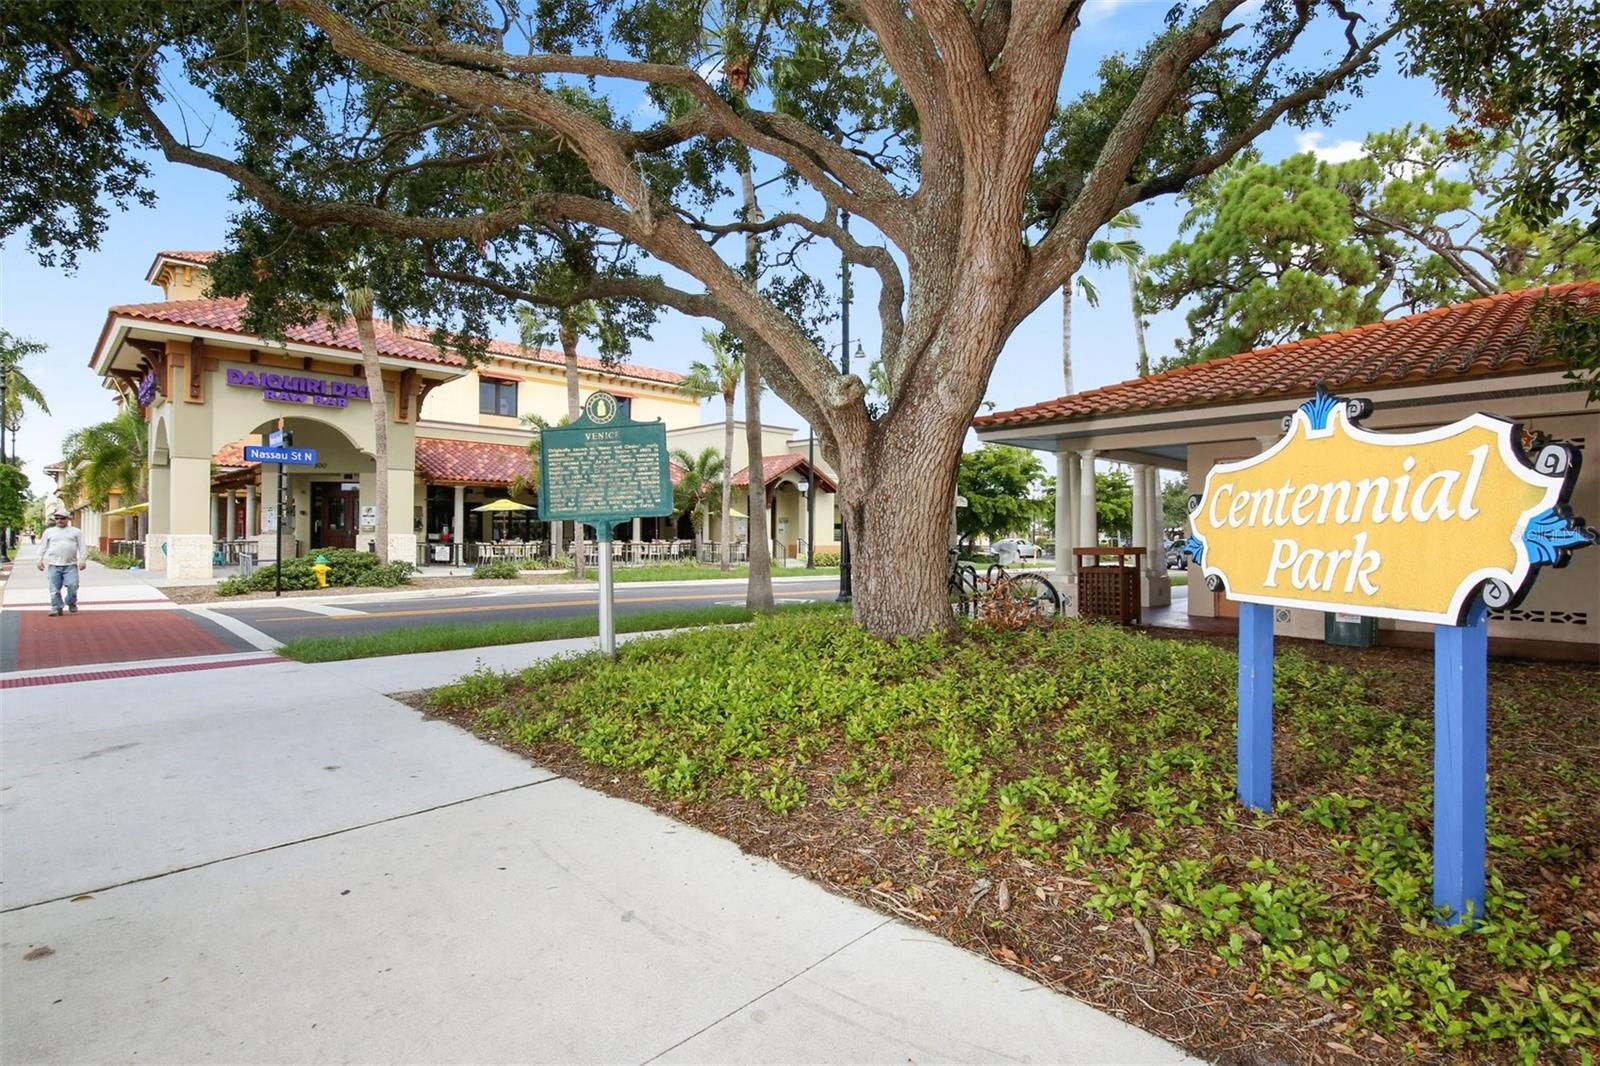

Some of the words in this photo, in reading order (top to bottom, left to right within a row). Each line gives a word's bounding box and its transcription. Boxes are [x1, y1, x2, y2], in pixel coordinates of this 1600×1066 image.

[226, 368, 327, 394] DAIQUIRI
[331, 381, 369, 399] DEC
[264, 389, 307, 403] RAW
[313, 394, 349, 408] BAR
[250, 449, 288, 460] Nassau
[291, 452, 302, 460] St
[304, 452, 312, 461] N
[1208, 443, 1490, 529] Centennial
[1263, 531, 1382, 597] Park
